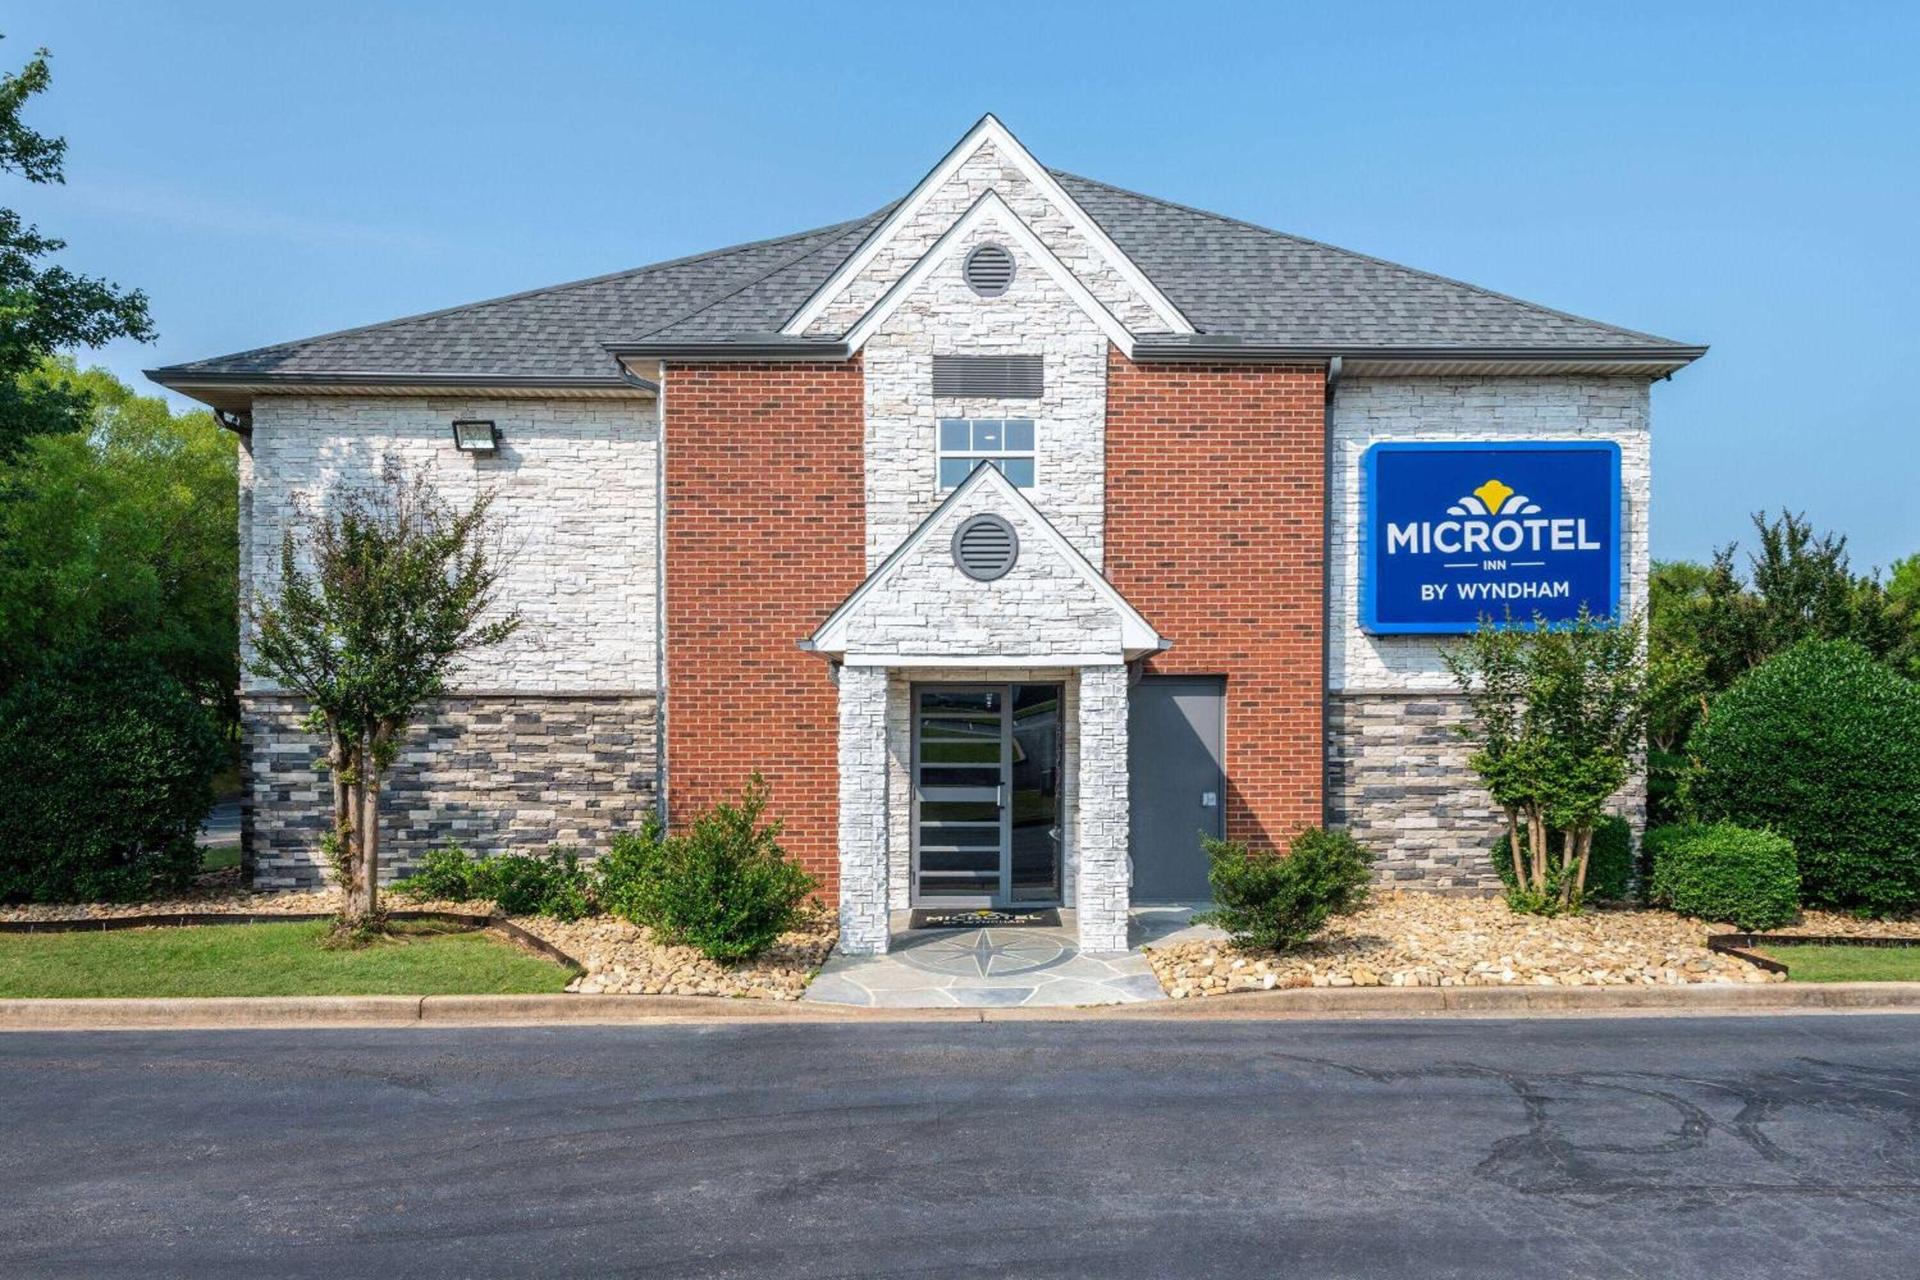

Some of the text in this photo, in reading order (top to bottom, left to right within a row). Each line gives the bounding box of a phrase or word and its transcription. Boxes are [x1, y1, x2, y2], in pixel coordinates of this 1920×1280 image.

[1387, 519, 1600, 554] MICROTEL
[1483, 560, 1507, 570] INN
[1421, 581, 1569, 600] BY WYNDHAM
